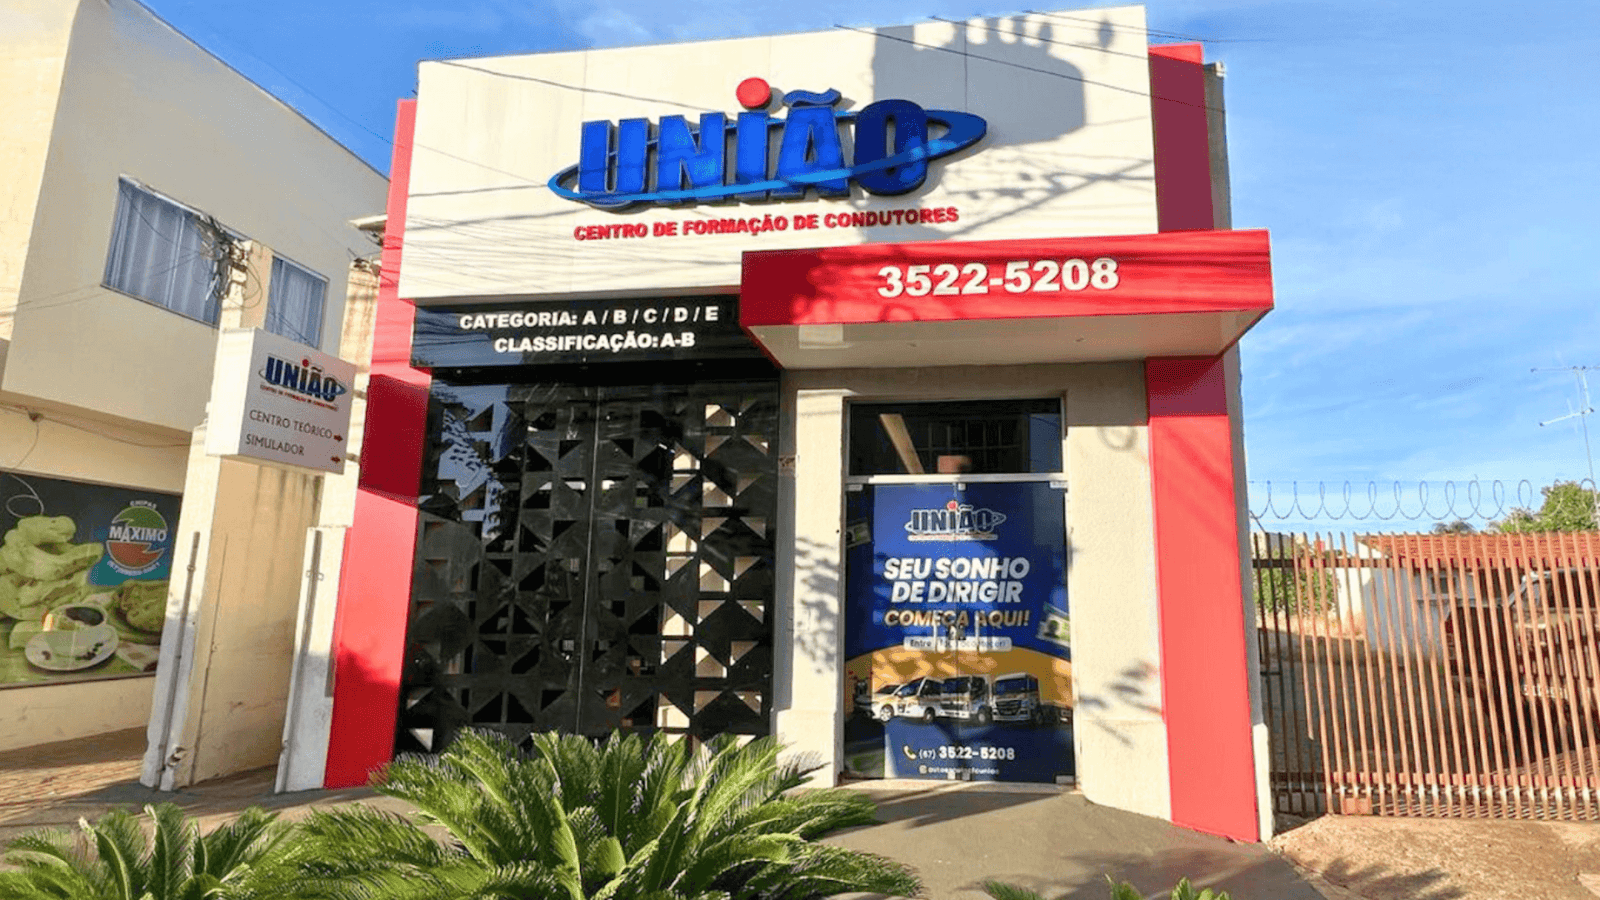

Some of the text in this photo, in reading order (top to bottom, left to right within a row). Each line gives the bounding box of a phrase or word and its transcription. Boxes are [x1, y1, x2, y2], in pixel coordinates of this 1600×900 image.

[574, 207, 960, 241] CENTRO DE FORMAÇÃO DE CONDUTORES
[877, 257, 1120, 298] 3522-5208
[459, 311, 577, 329] CATEGORIA:
[249, 409, 290, 429] CENTRO
[246, 433, 304, 456] SIMULADOR
[883, 557, 1030, 580] SEU SONHO
[891, 580, 1024, 603] DE DIRIGIR
[939, 746, 1015, 760] 3522-5208
